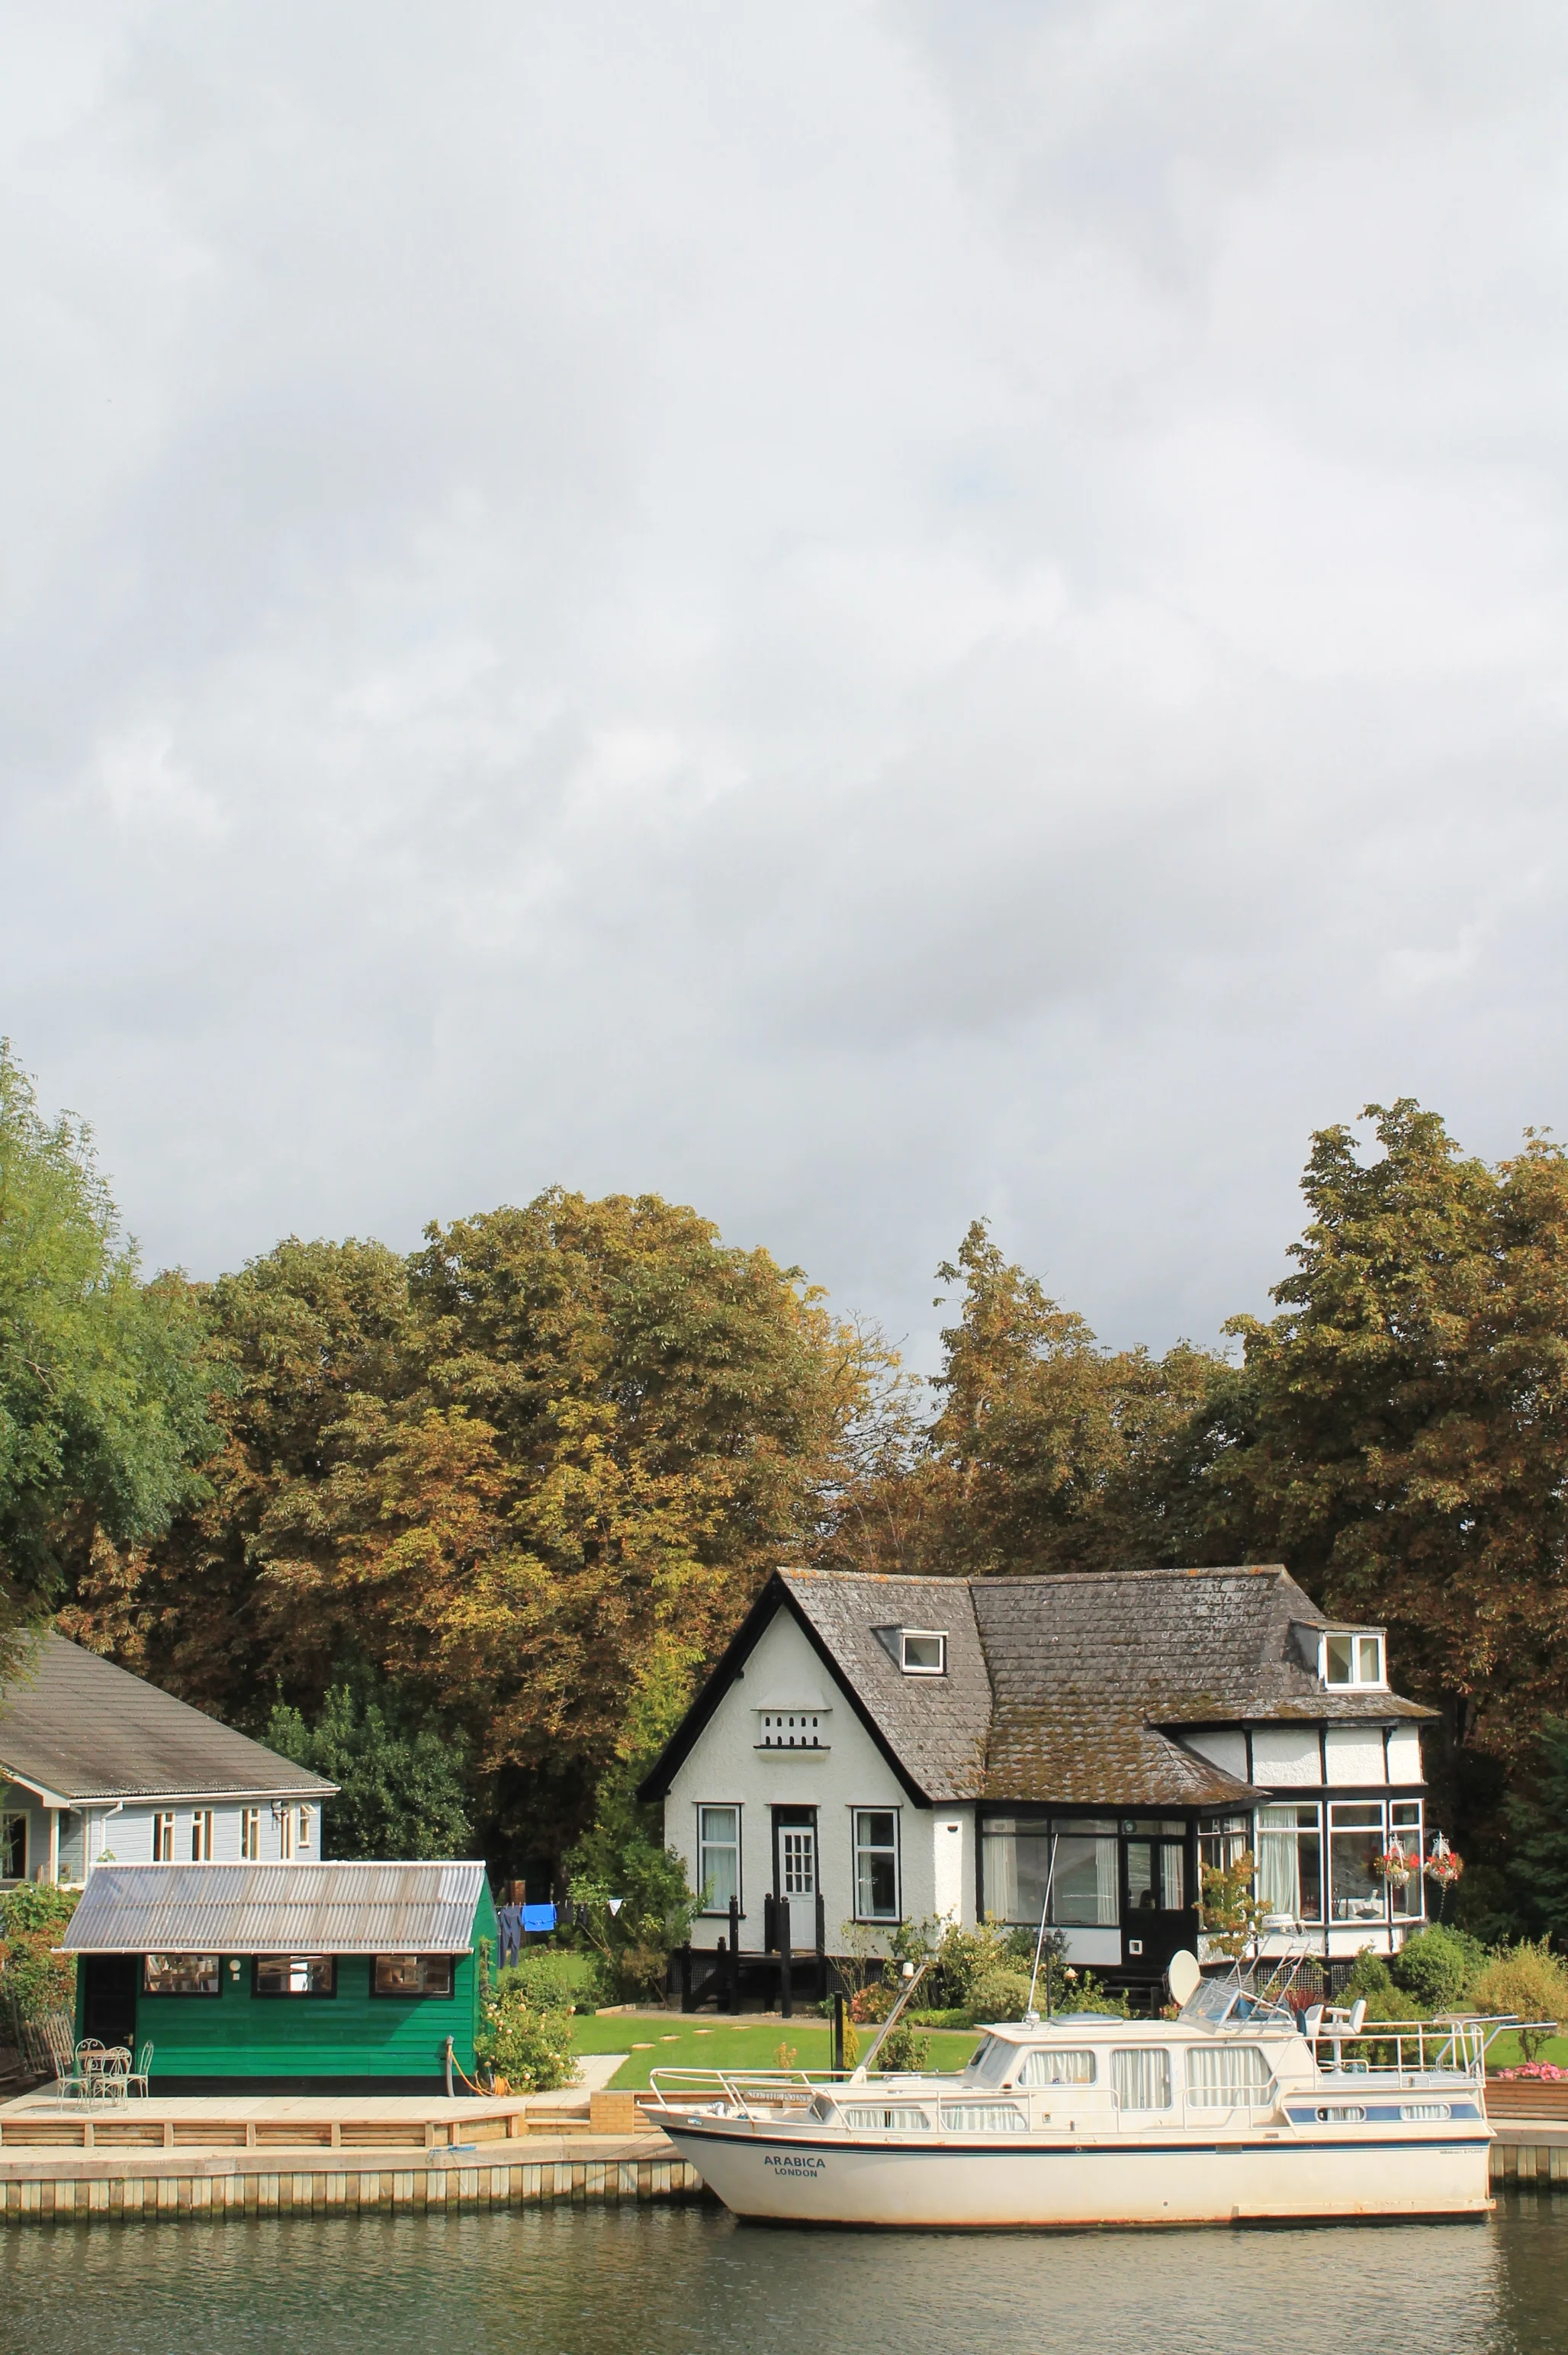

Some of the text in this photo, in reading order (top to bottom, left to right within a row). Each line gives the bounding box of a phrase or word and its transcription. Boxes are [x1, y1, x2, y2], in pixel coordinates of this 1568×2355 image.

[764, 2092, 781, 2101] THE
[783, 2093, 810, 2103] POINT
[764, 2155, 826, 2167] ARABICA
[775, 2167, 818, 2177] LONDON
